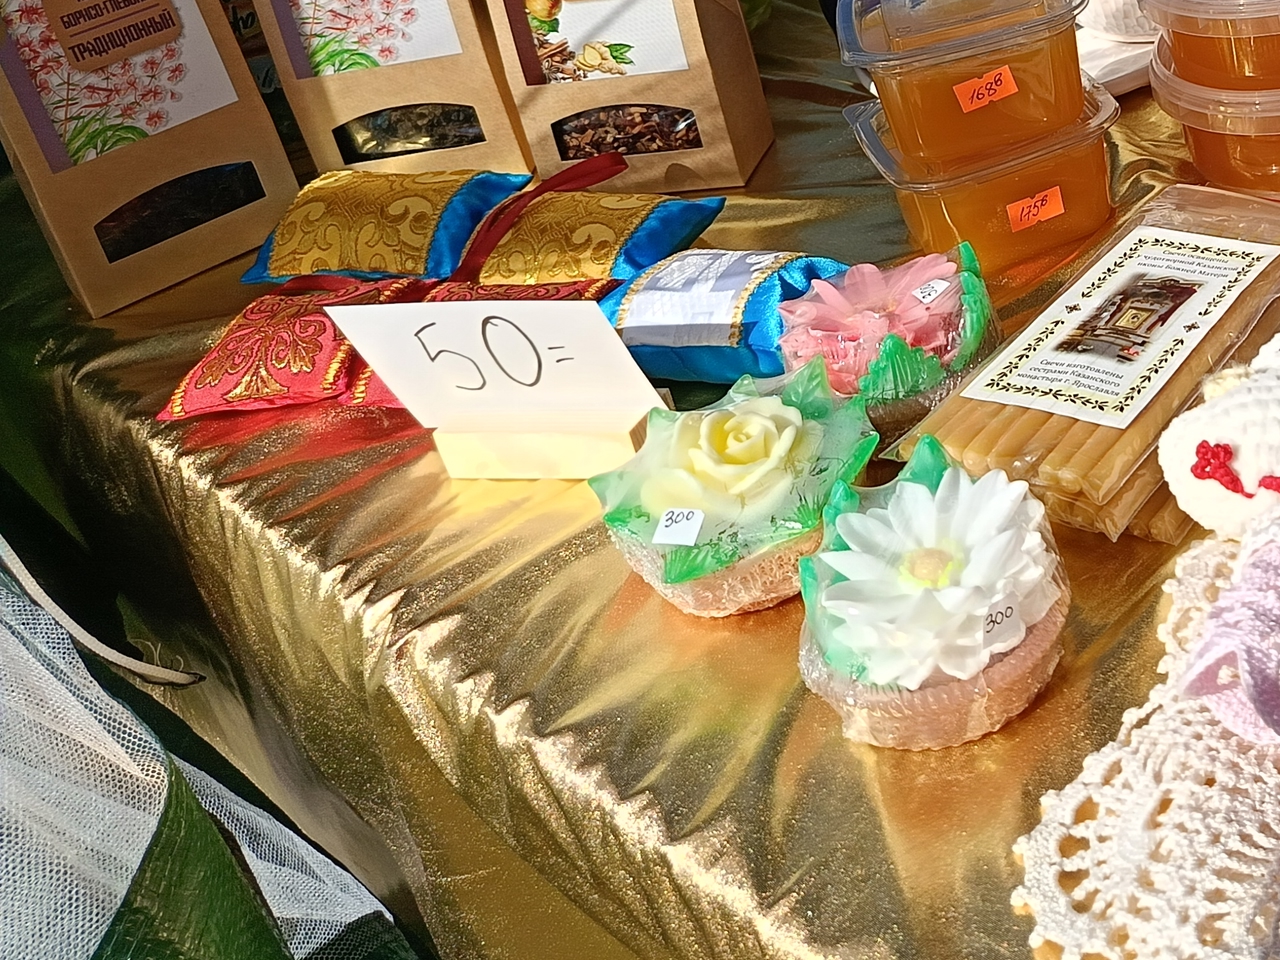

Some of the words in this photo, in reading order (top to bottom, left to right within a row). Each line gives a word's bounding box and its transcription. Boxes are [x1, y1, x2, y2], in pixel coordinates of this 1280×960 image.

[68, 8, 176, 63] ТРАДИЦИОННЫЙ
[1196, 262, 1239, 271] Казанской
[1197, 270, 1230, 278] Матери
[1029, 366, 1070, 375] сестрами
[1070, 370, 1121, 388] Казанского
[1040, 359, 1065, 367] Свечи
[1066, 362, 1124, 380] изготовлены
[1016, 373, 1062, 383] монастыря
[1071, 380, 1121, 397] Ярославля
[664, 510, 695, 528] 300
[985, 606, 1014, 633] 300
